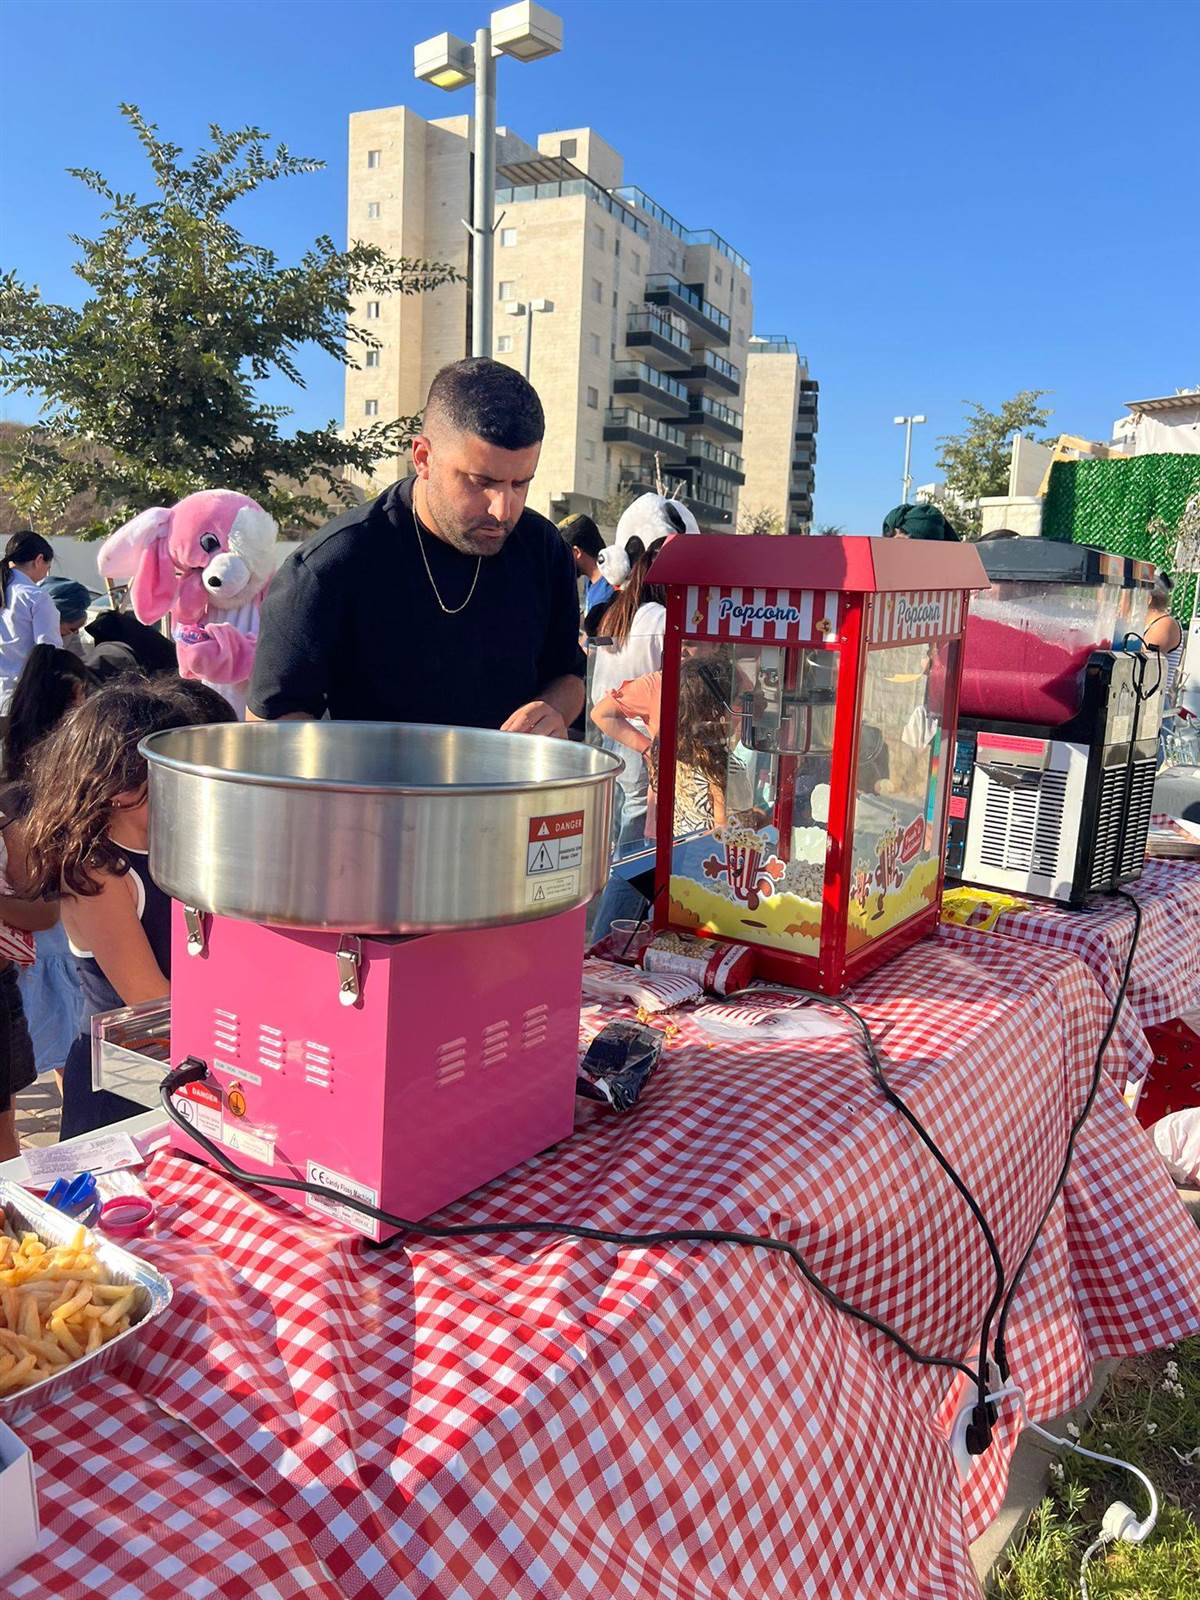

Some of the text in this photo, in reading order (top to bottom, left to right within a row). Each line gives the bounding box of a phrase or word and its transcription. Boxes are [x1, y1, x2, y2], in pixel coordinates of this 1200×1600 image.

[719, 598, 800, 626] Popcorn
[897, 599, 940, 630] Popcorn
[555, 818, 583, 832] DANGER
